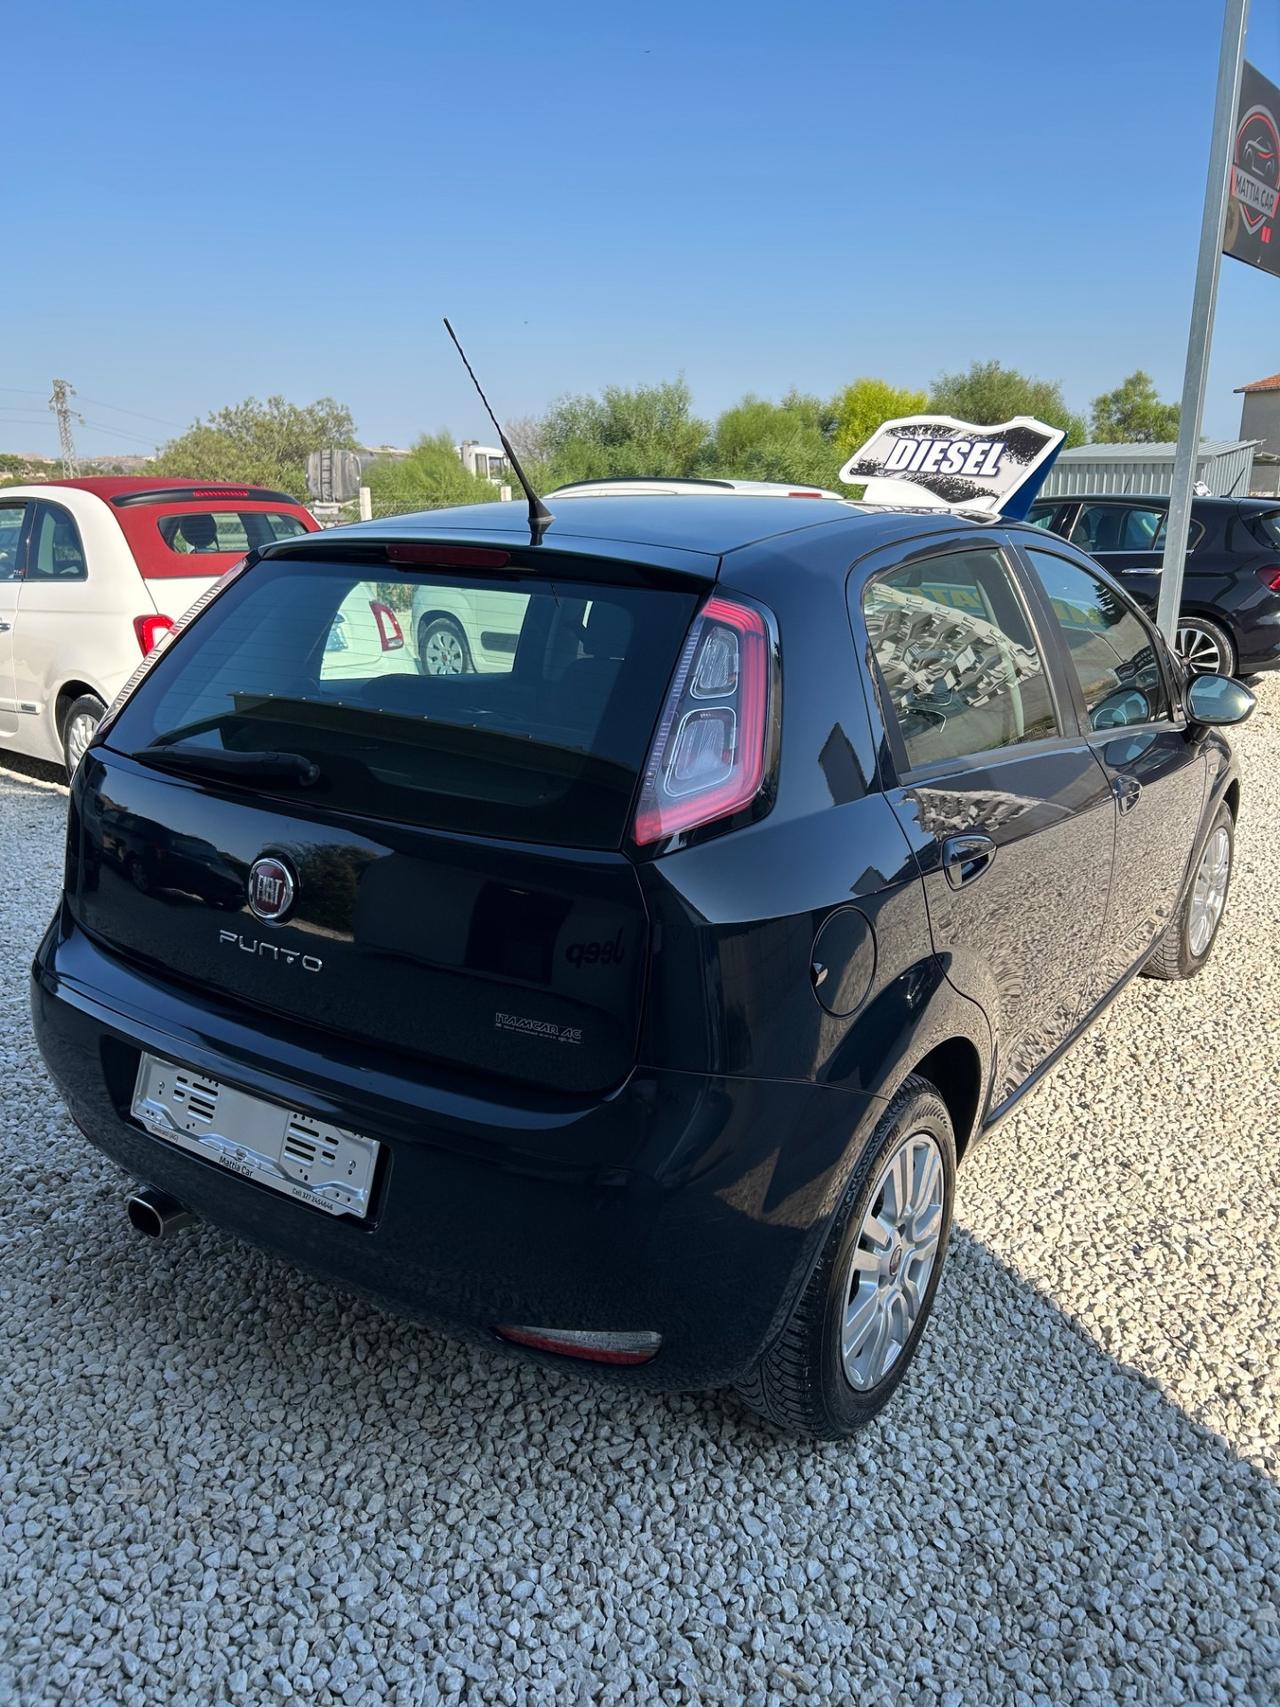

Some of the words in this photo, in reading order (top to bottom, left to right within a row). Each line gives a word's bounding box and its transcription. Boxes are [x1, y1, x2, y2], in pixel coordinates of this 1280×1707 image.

[1236, 173, 1260, 205] MATTIA
[1261, 188, 1275, 212] CAR
[883, 438, 1006, 477] DIESEL
[256, 873, 283, 905] FIAT
[219, 928, 323, 972] PUNTO
[219, 1155, 240, 1172] Mattia
[241, 1165, 254, 1177] Car
